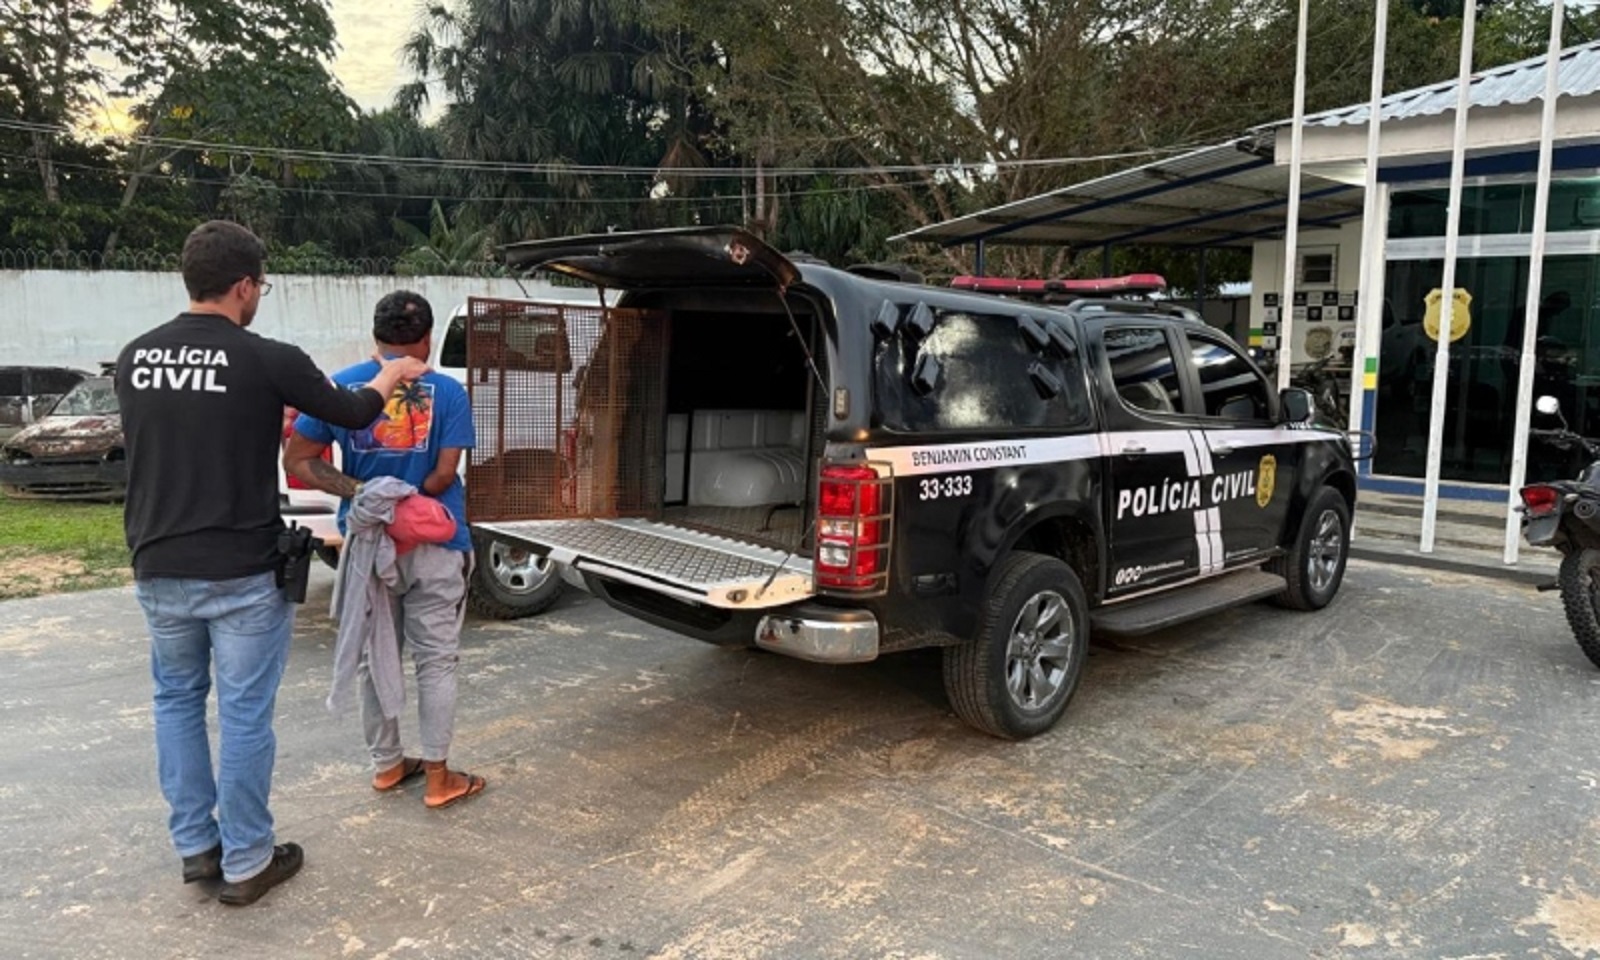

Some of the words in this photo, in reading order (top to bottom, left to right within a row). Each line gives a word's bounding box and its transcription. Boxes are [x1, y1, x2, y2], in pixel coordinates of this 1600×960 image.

[133, 345, 229, 367] POLÍCIA
[131, 366, 227, 393] CIVIL
[911, 447, 973, 467] BENJAMIN
[973, 445, 1027, 462] CONSTANT
[919, 475, 973, 501] 33-333
[1117, 477, 1201, 520] POLÍCIA
[1211, 470, 1256, 504] CIVIL
